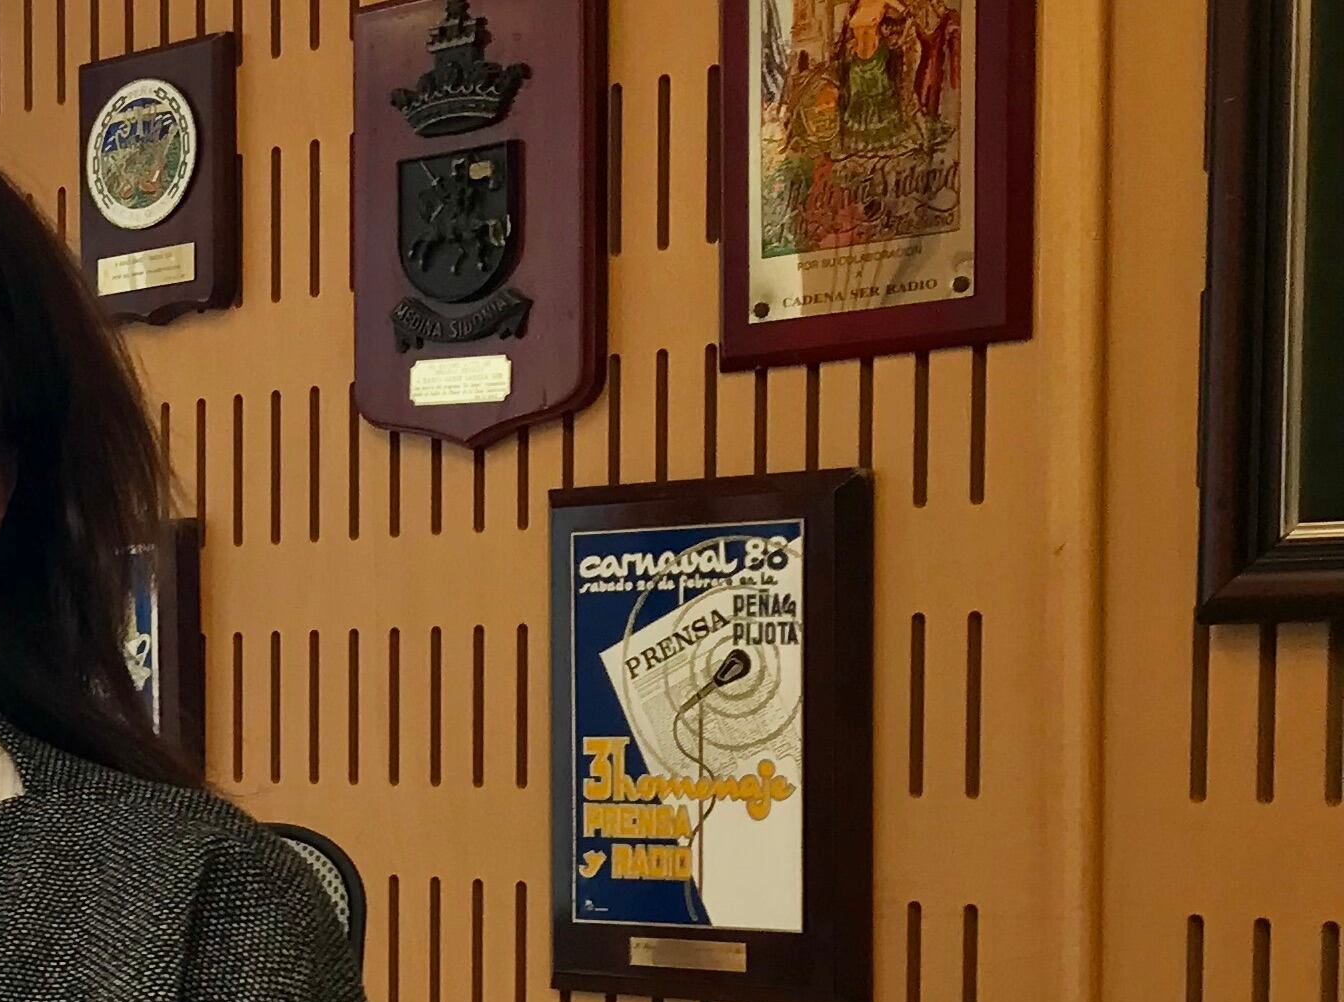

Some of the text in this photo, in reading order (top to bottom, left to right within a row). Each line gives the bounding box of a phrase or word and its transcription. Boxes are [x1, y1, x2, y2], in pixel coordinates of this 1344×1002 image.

[782, 278, 938, 309] CADENA SER RADIO
[395, 299, 508, 338] MEDINA SIDONIA
[579, 535, 789, 578] carnaval 88
[657, 576, 676, 591] de
[732, 588, 782, 618] PEÑA
[624, 608, 730, 681] PRENSA
[732, 620, 800, 646] PIJOTA
[610, 736, 797, 822] homenaje
[582, 802, 693, 839] PRENSA
[611, 843, 693, 881] RADIO
